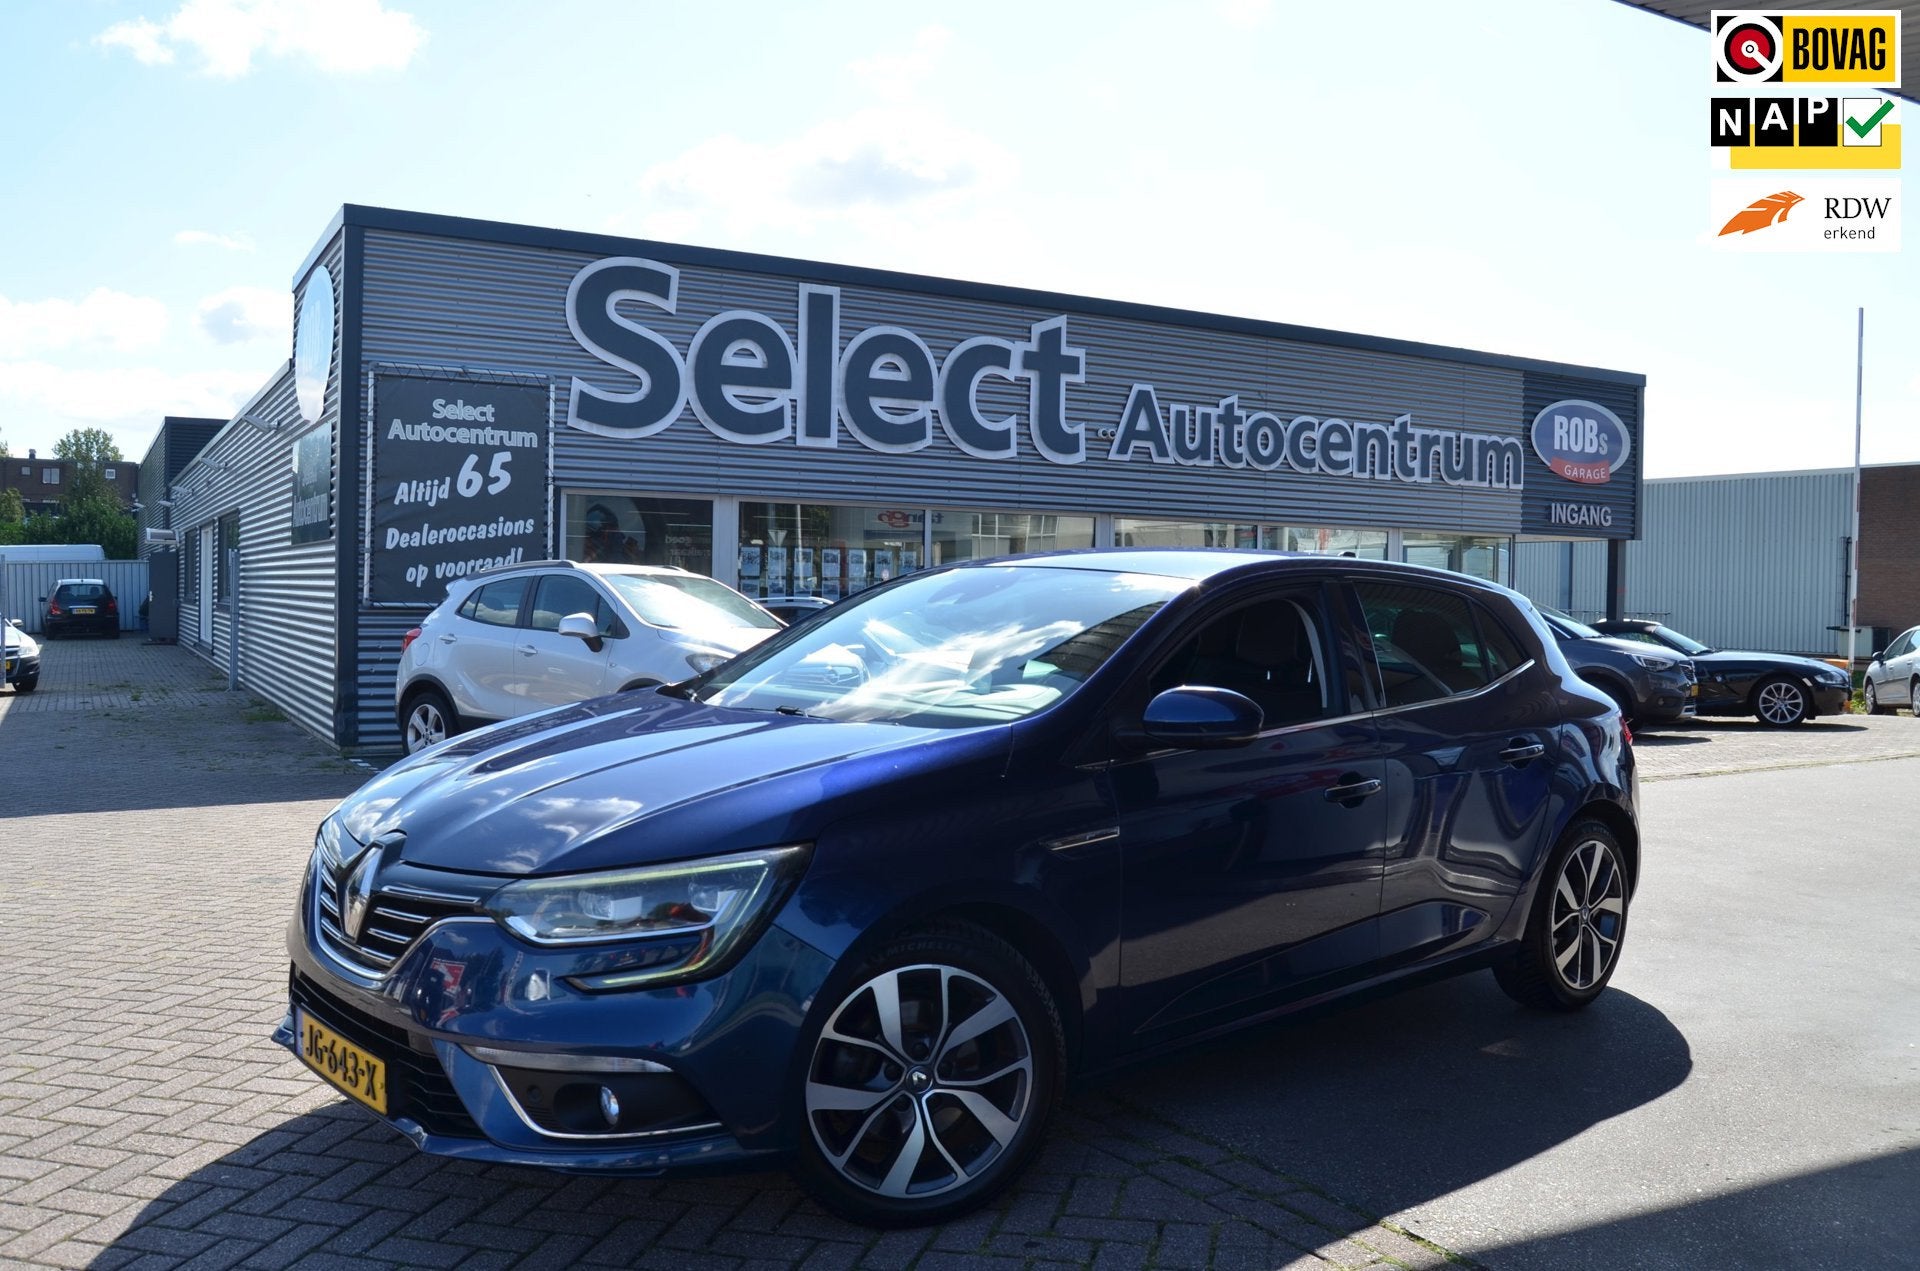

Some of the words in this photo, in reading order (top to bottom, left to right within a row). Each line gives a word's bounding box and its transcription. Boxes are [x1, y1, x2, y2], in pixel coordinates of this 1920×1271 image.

[566, 256, 1086, 465] Select
[1108, 383, 1524, 490] Autocentrum
[432, 398, 495, 422] Select
[387, 419, 538, 448] Autocentrum
[1554, 415, 1608, 455] ROBs
[393, 477, 450, 507] Altijd
[456, 451, 512, 498] 65
[1564, 464, 1606, 479] GARAGE
[1551, 502, 1612, 527] INGANG
[385, 517, 535, 550] Dealeroccasions
[405, 564, 428, 588] op
[305, 1024, 377, 1101] JG-643-X
